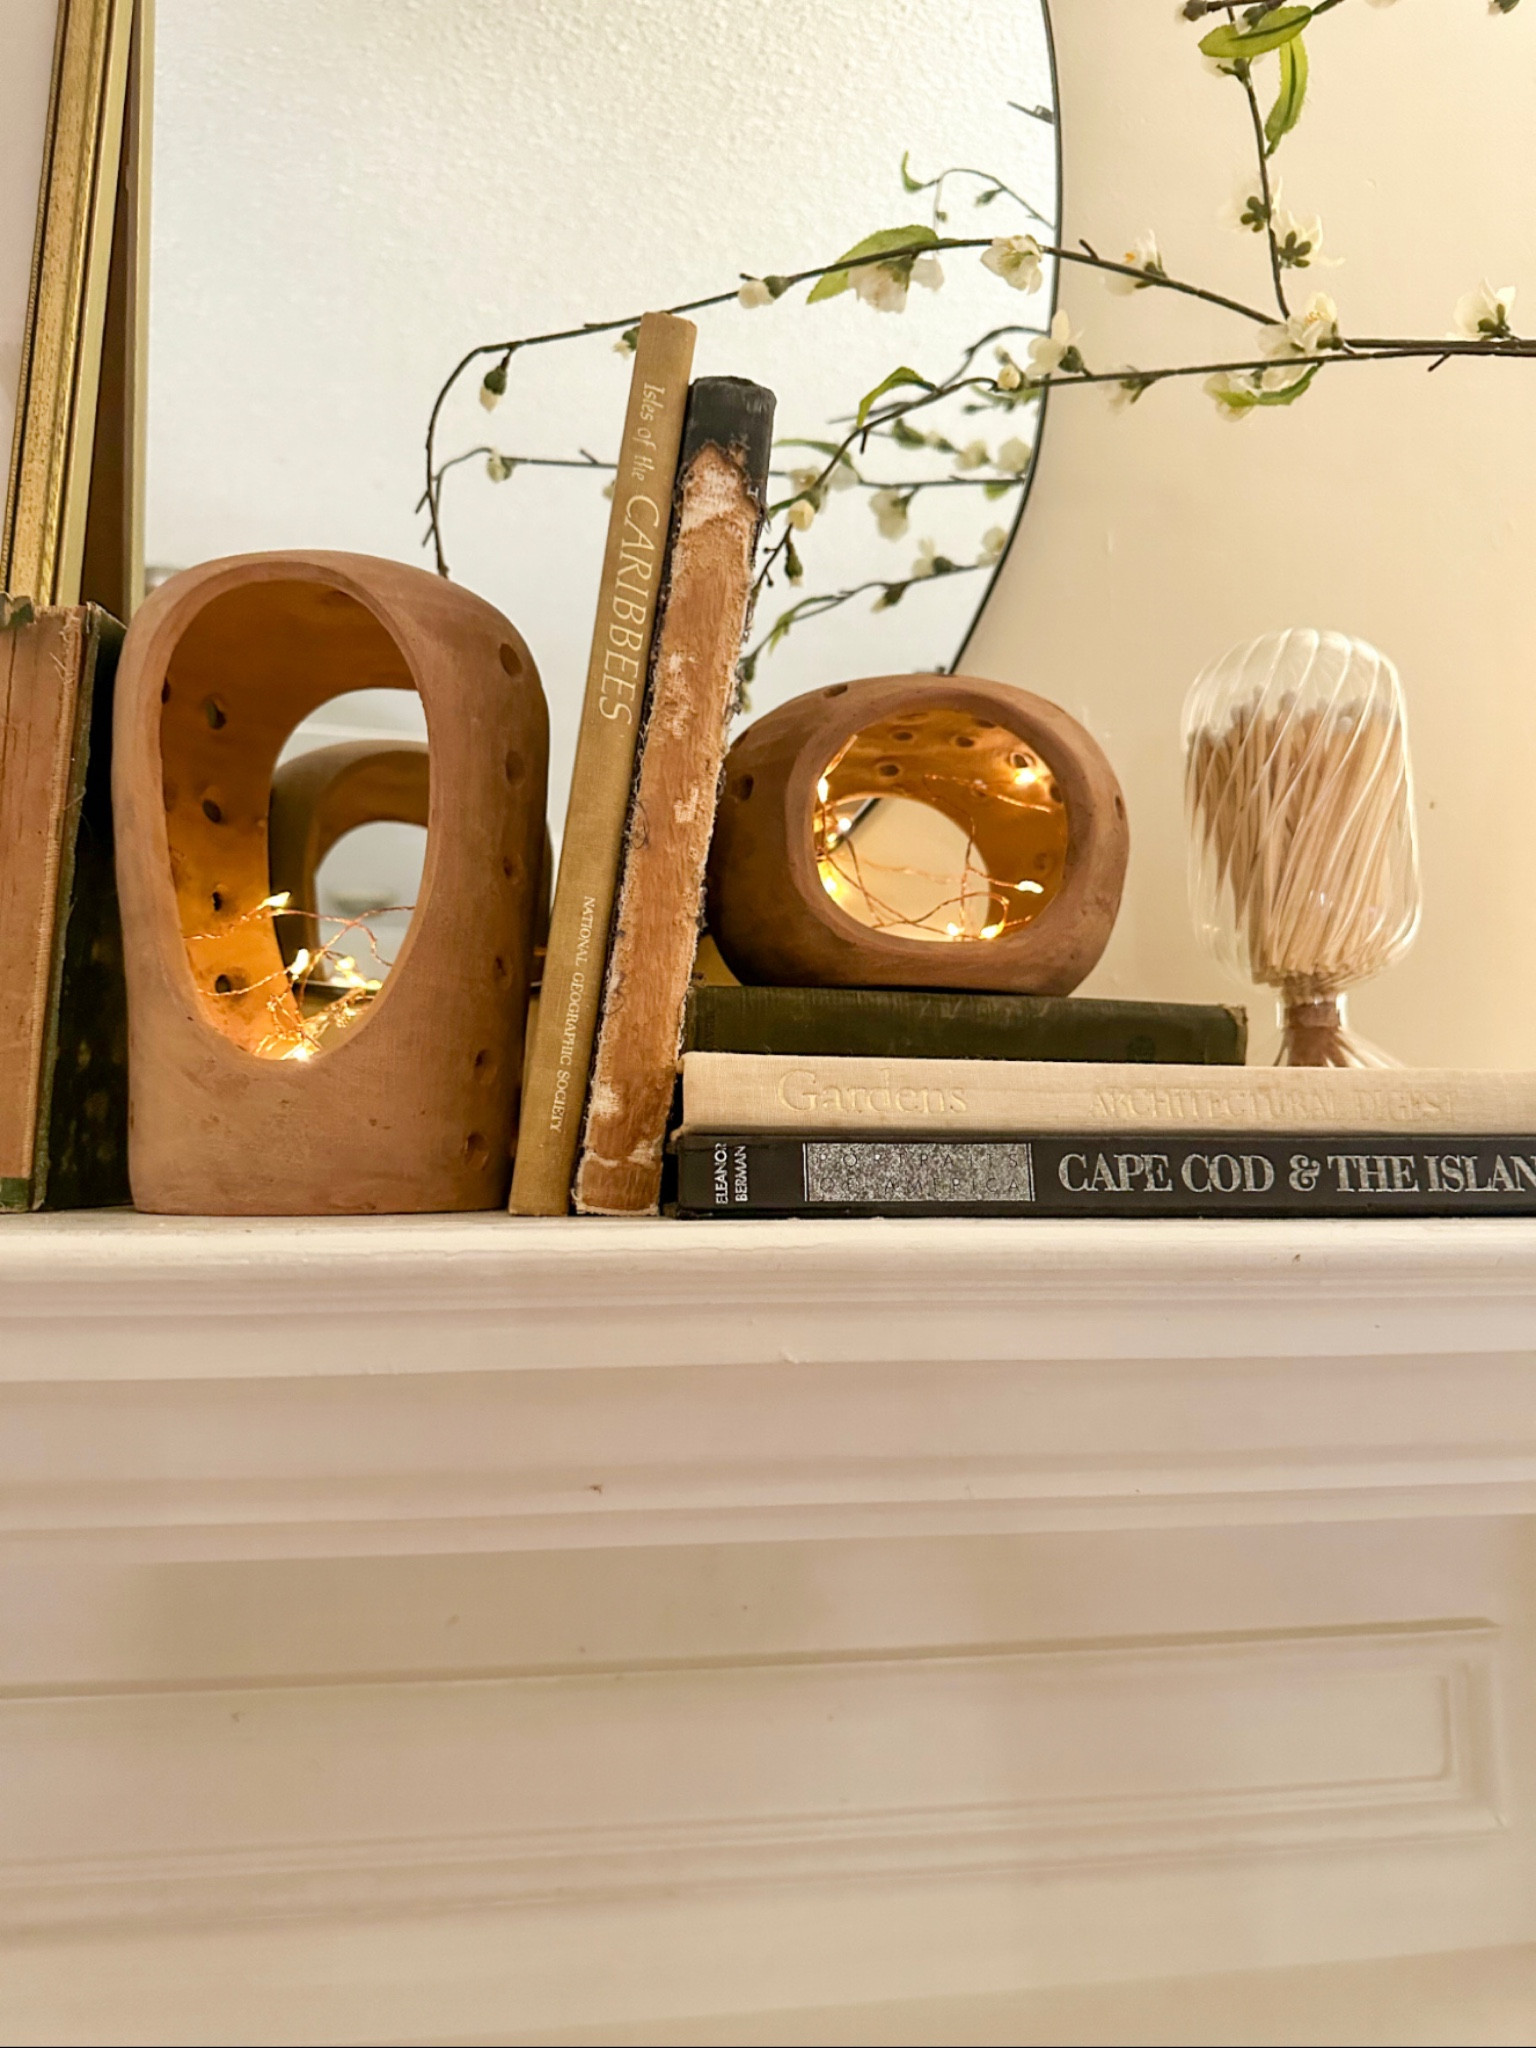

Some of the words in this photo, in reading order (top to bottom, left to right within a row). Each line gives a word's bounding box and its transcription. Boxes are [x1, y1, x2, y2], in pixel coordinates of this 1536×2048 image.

[640, 382, 665, 421] Isles
[632, 427, 656, 451] of
[632, 455, 655, 481] the
[599, 495, 660, 725] CARIBBEES
[575, 895, 596, 967] NATIONAL
[560, 972, 585, 1066] GEOGRAPHIC
[550, 1069, 571, 1132] SOCIETY
[778, 1067, 967, 1113] Gardens
[1089, 1086, 1337, 1121] ARCHITECTURAL
[1352, 1089, 1457, 1122] DIGEST
[714, 1142, 728, 1204] ELEANOR
[734, 1145, 748, 1202] BERMAN
[1058, 1153, 1173, 1191] CAPE
[1181, 1153, 1275, 1191] COD
[1289, 1154, 1321, 1191] &
[1327, 1154, 1419, 1192] THE
